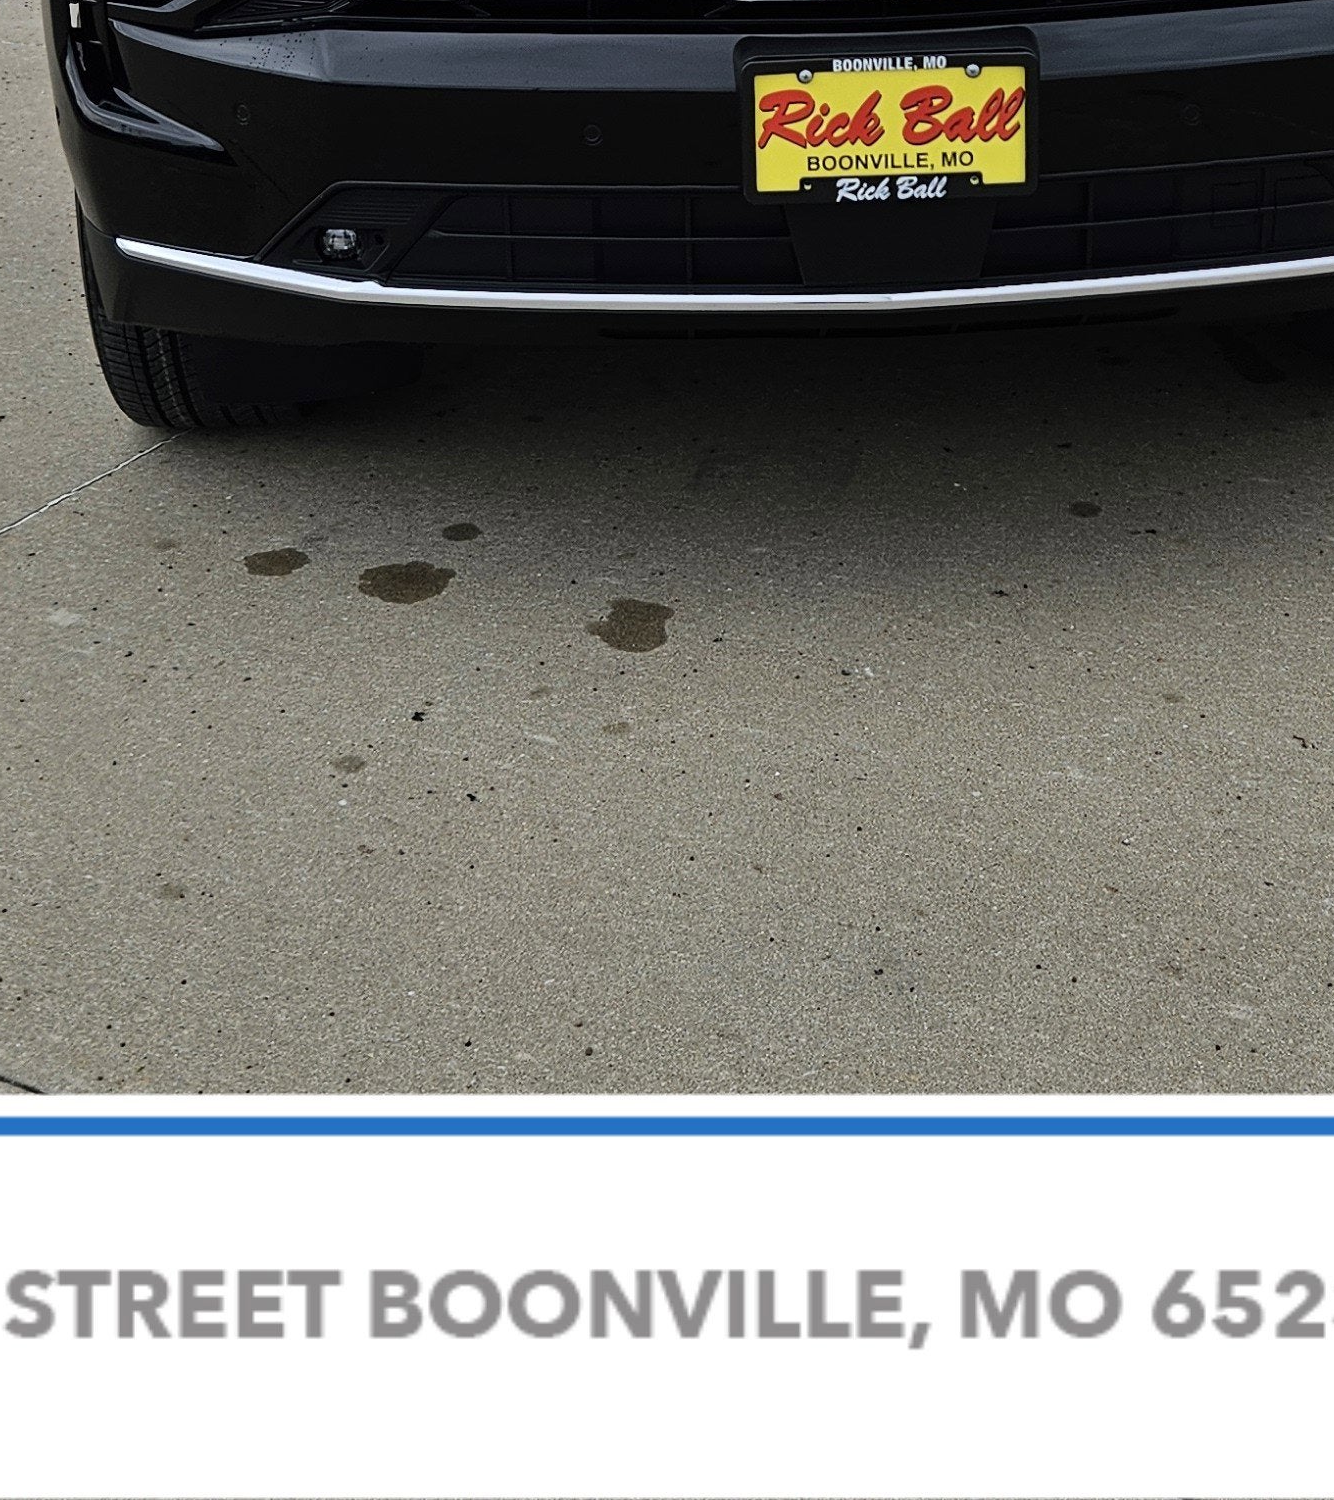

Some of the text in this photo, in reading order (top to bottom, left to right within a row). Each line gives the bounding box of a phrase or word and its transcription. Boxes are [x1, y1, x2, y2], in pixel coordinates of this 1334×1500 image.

[832, 55, 947, 73] BOONVILLE, MO
[757, 84, 1026, 149] Rick Ball
[806, 150, 974, 172] BOONVILLE, MO
[835, 175, 947, 203] Rick Ball
